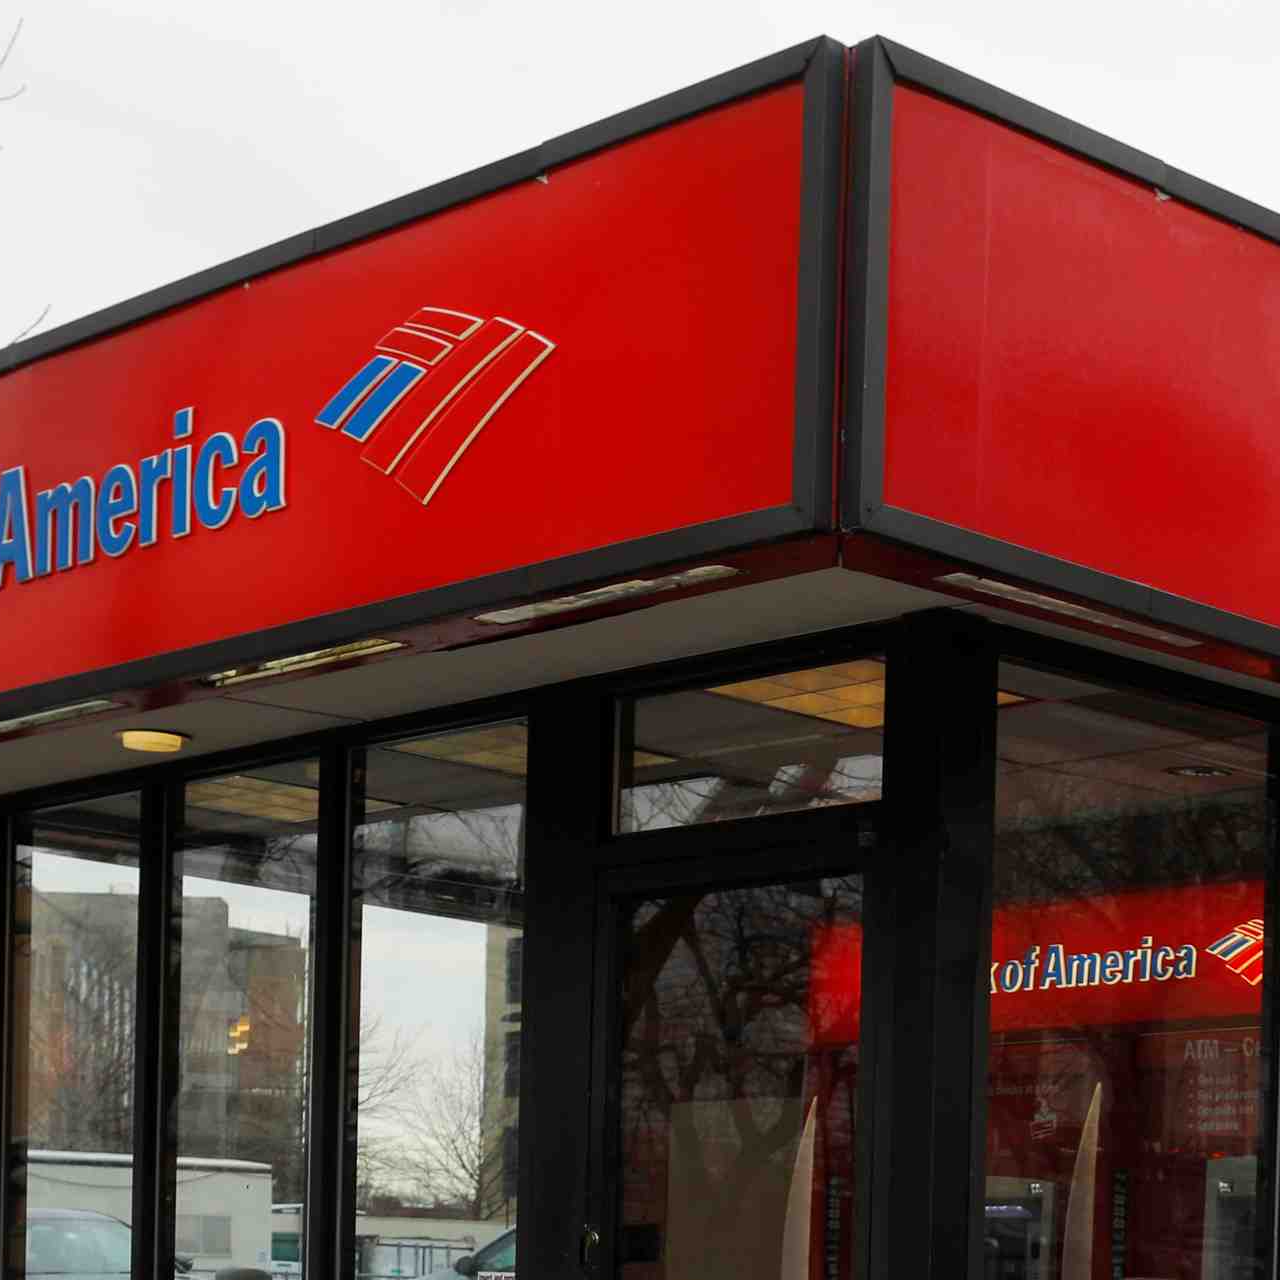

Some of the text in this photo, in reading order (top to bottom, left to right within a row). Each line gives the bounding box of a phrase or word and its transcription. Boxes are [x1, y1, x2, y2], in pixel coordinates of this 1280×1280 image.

[1003, 945, 1040, 993] of
[1041, 936, 1196, 990] America
[1184, 1039, 1220, 1060] ATM
